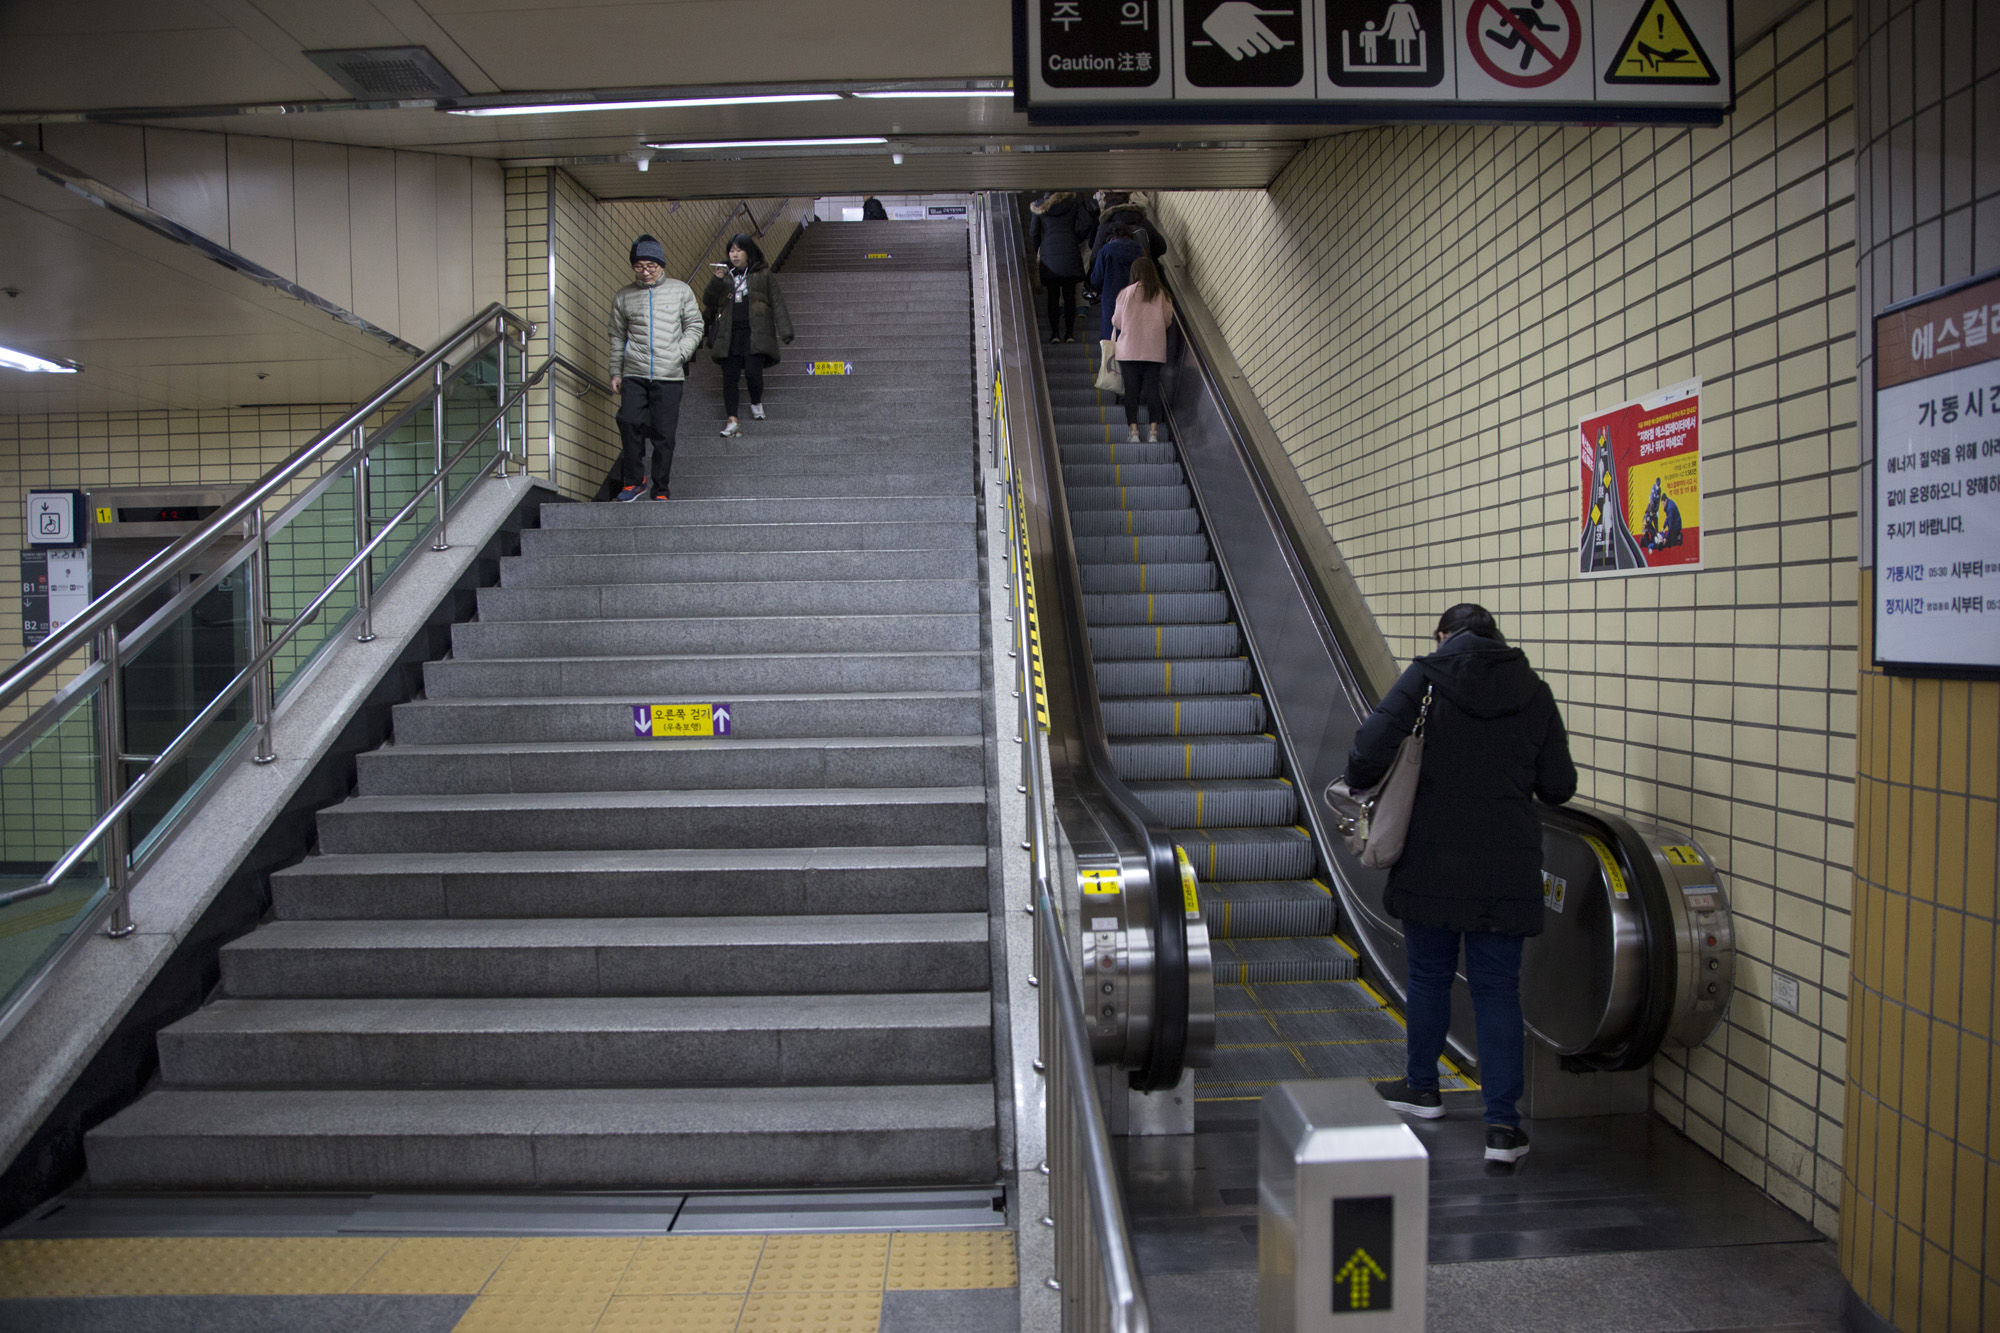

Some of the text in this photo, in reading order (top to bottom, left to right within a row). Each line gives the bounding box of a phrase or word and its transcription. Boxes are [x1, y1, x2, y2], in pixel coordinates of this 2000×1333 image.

[1048, 52, 1152, 71] Caution 注意
[1655, 416, 1696, 438] 에스컬레이터에서
[1640, 441, 1655, 457] 걷거나
[1655, 439, 1666, 453] 뛰지
[1887, 453, 1916, 474] 에너지
[1920, 447, 1951, 469] 절약을
[1955, 442, 1977, 463] 위해
[1887, 488, 1906, 507] 같이
[1910, 480, 1962, 504] 운영하오니
[99, 508, 106, 522] 1
[1887, 515, 1965, 540] 주시기 바랍니다.
[1886, 564, 1924, 582] 가동시간
[1951, 560, 1983, 579] 시부터
[23, 582, 35, 593] B1
[1886, 597, 1924, 615] 정지시간
[1951, 595, 1983, 614] 시부터
[24, 620, 37, 631] B2
[654, 708, 711, 721] 오른쪽 걷기
[663, 722, 702, 732] (우측보행)
[1669, 846, 1687, 864] 1
